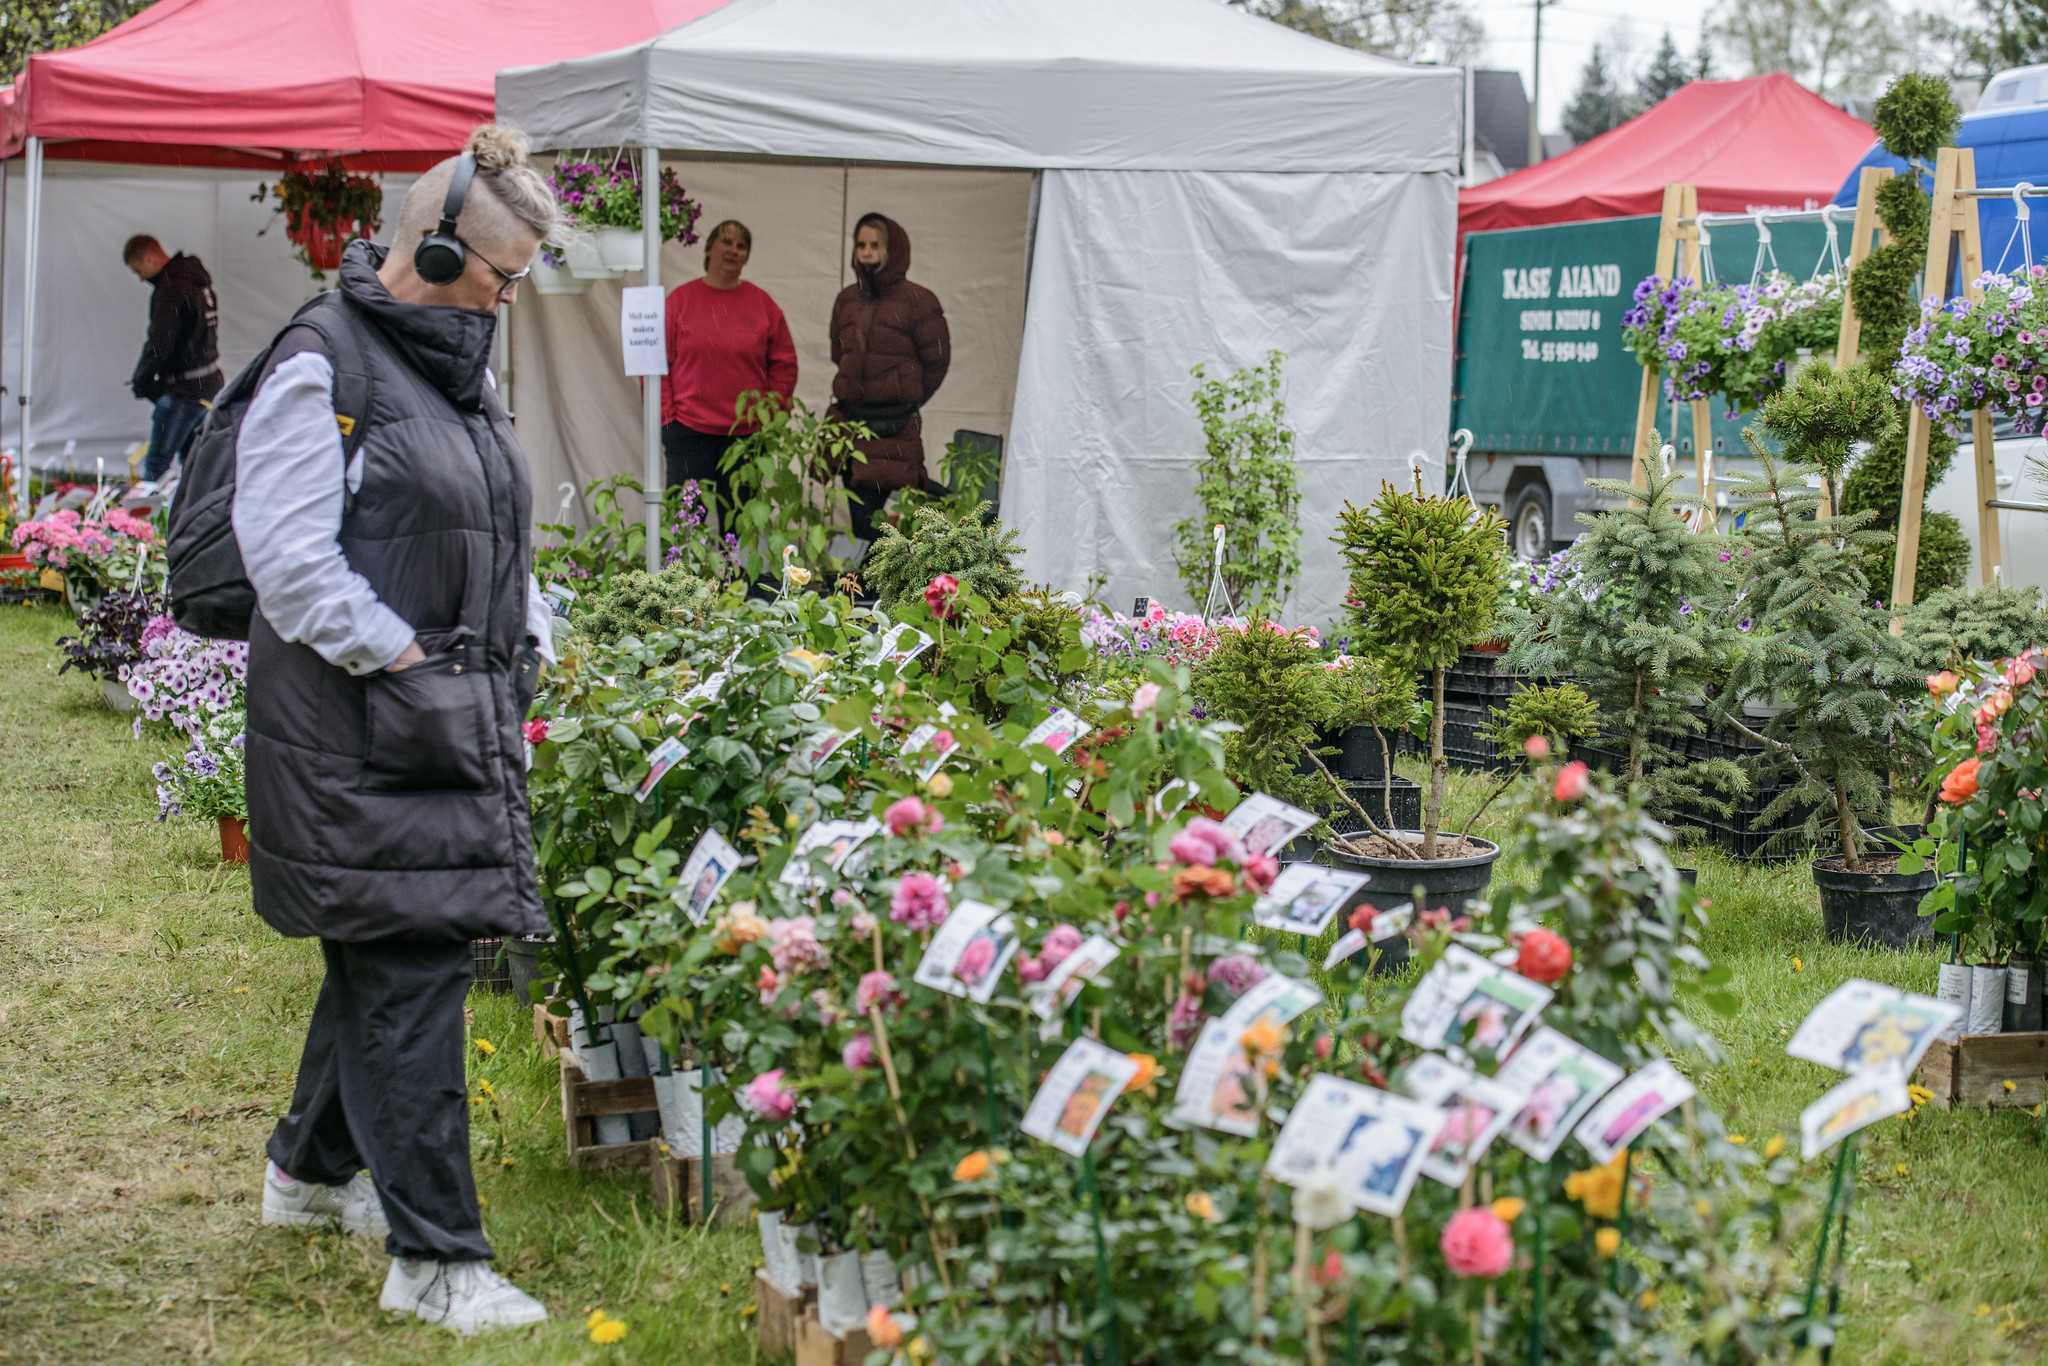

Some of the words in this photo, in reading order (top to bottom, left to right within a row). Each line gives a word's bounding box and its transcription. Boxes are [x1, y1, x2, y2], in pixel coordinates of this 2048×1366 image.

[1502, 267, 1552, 299] KASE
[1557, 264, 1621, 298] AIAND
[1521, 339, 1541, 359] Tel.
